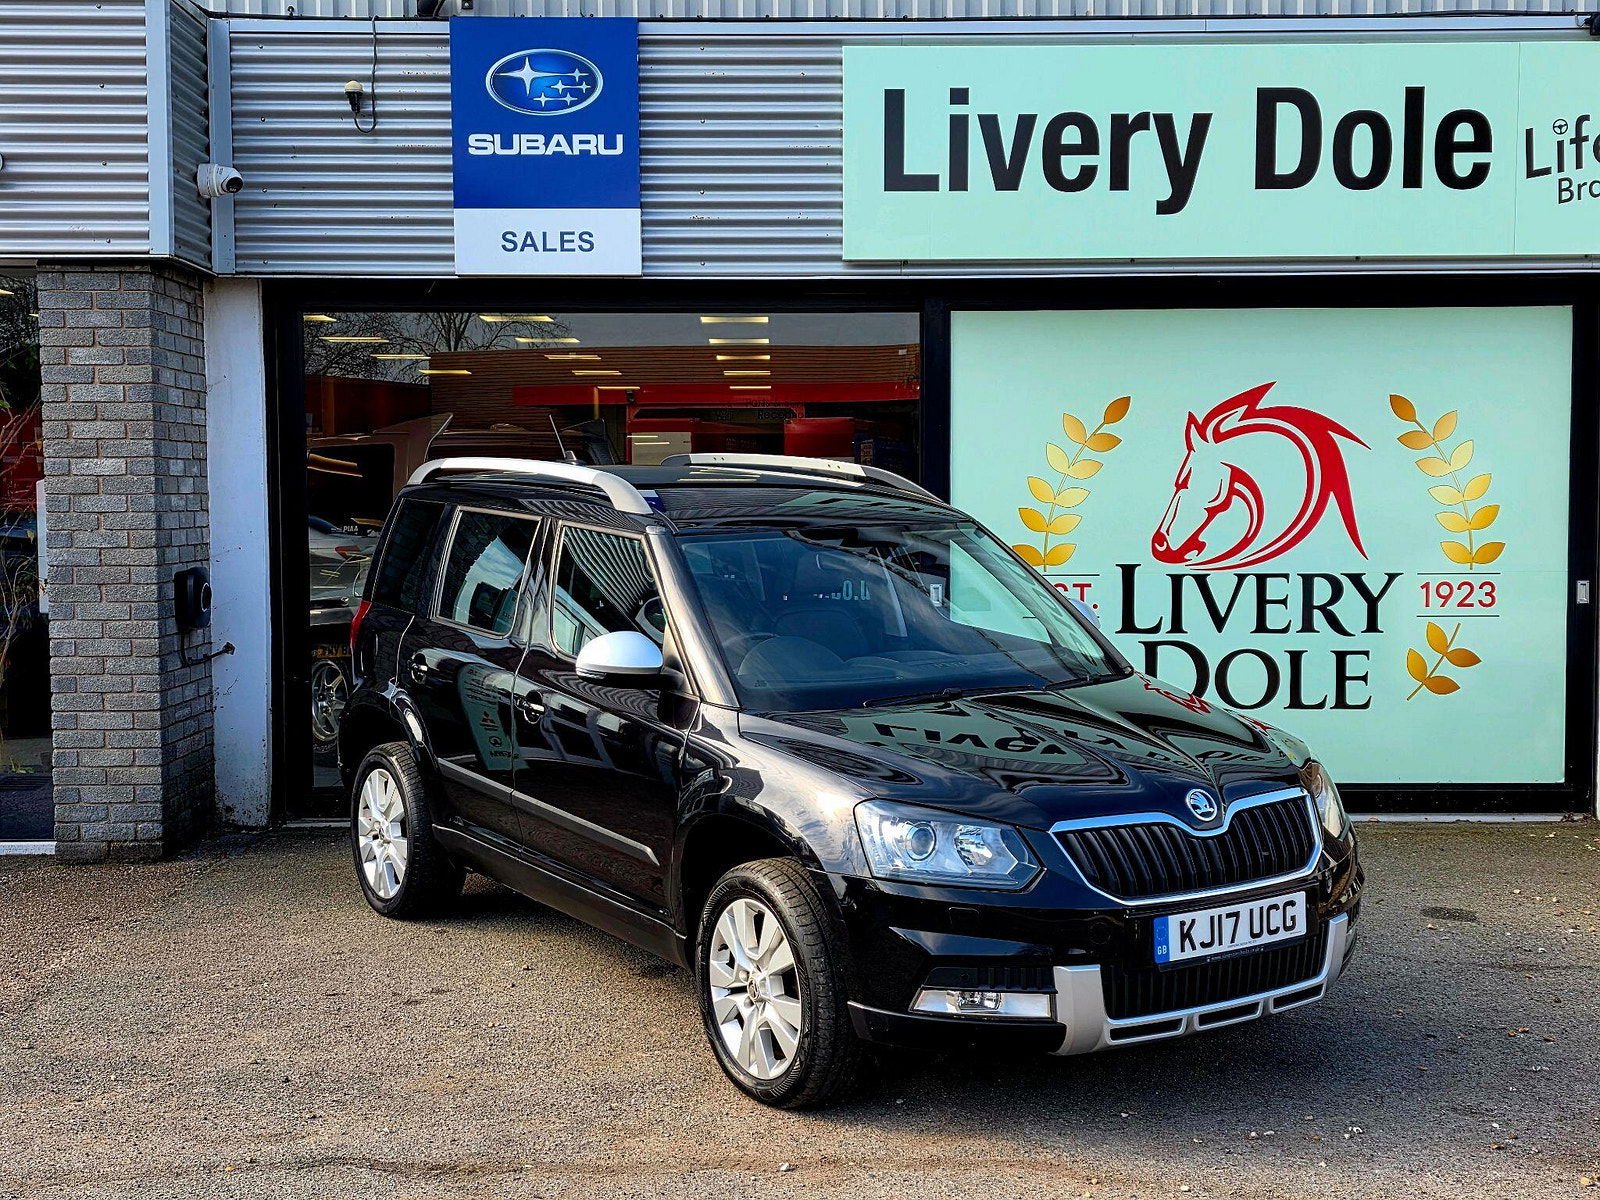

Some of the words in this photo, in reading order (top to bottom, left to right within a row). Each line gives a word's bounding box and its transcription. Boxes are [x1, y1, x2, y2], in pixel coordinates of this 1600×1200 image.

[468, 133, 624, 156] SUBARU
[884, 87, 1213, 215] Livery
[1254, 86, 1492, 191] Dole
[1525, 114, 1600, 179] Lif
[501, 230, 595, 252] SALES
[1115, 563, 1404, 637] LIVERY
[1420, 581, 1497, 609] 1923
[1138, 640, 1373, 710] DOLE
[1157, 944, 1168, 955] GB
[1179, 910, 1241, 953] KJ17
[1249, 899, 1298, 940] UCG
